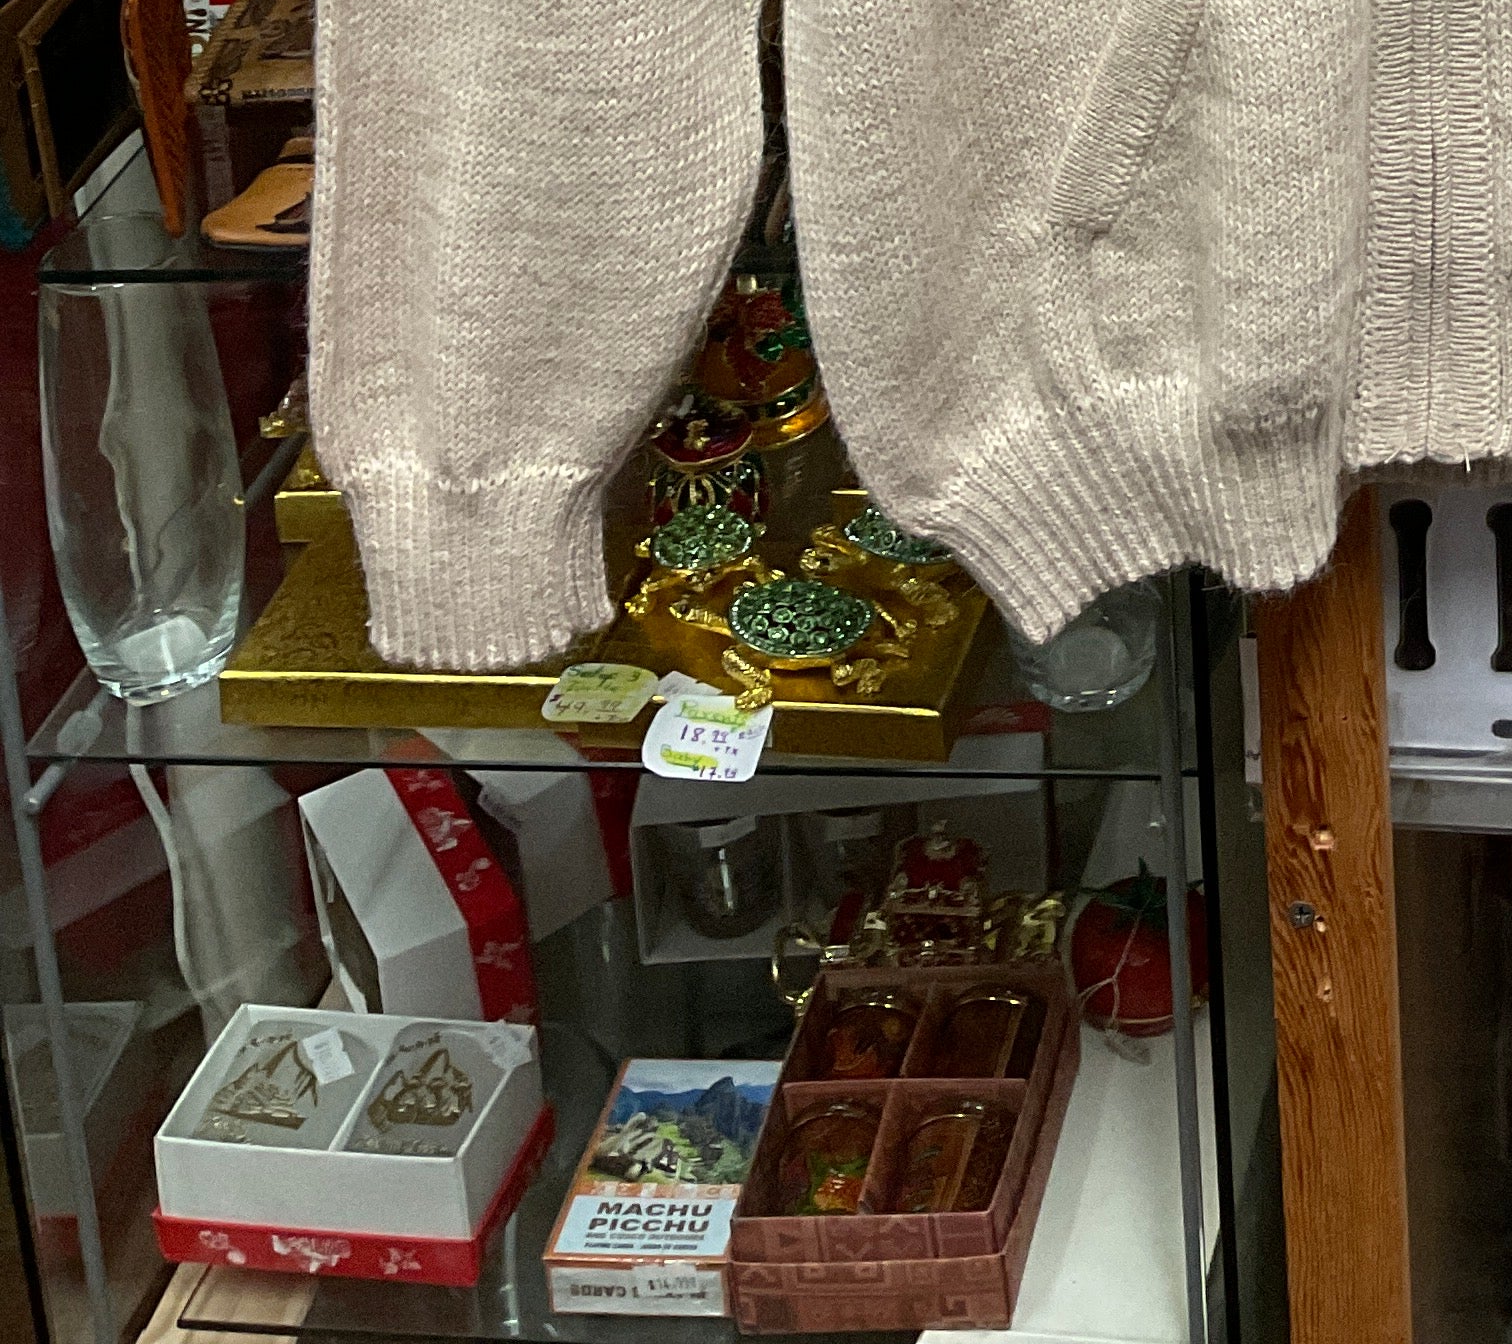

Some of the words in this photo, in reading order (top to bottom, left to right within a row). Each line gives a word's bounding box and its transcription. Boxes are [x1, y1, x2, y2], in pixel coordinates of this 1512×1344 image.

[1389, 499, 1434, 672] I
[596, 1201, 713, 1217] MACHU
[588, 1217, 711, 1233] PICCHU
